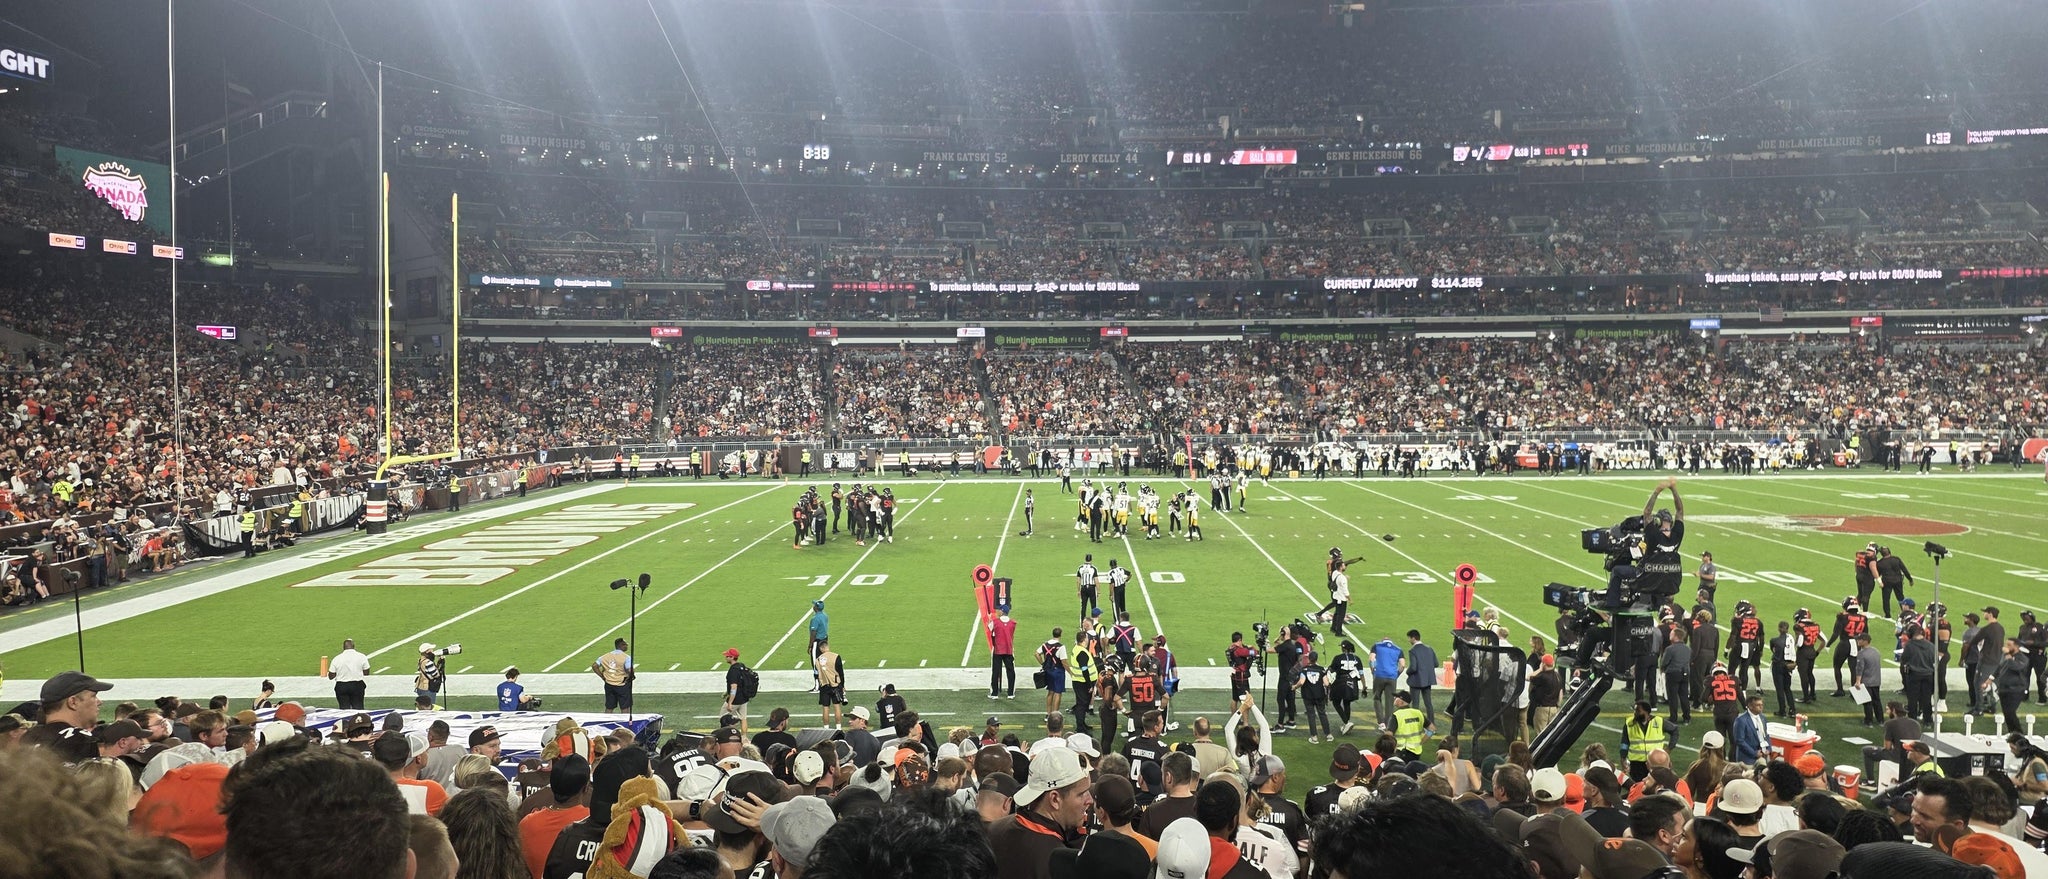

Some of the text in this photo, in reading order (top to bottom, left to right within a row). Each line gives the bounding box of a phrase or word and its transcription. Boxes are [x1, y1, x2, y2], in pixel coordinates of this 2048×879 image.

[0, 49, 49, 79] GHT
[500, 134, 586, 149] CHAMPIONSHIPS
[1605, 145, 1630, 154] MIKE
[1701, 141, 1713, 152] 74
[1757, 139, 1776, 149] JOE
[1868, 135, 1882, 146] 64
[923, 151, 1008, 163] FRANK GATSKI 52
[1060, 153, 1138, 164] LEROY KELLY 44
[1326, 150, 1422, 161] GENE HICKERSON 66
[1704, 273, 1714, 283] To
[1714, 273, 1750, 284] purchase
[1800, 273, 1818, 284] your
[1849, 271, 1859, 280] or
[1859, 270, 1877, 280] look
[1877, 269, 1890, 280] for
[1915, 268, 1942, 279] Kiosks
[929, 282, 938, 291] To
[938, 282, 971, 292] purchase
[999, 283, 1016, 291] scan
[1016, 283, 1033, 293] your
[1059, 283, 1068, 291] or
[1068, 282, 1084, 291] look
[1084, 282, 1096, 291] for
[1096, 281, 1116, 291] 50/50
[1324, 277, 1419, 289] CURRENT JACKPOT
[705, 336, 751, 345] Huntington
[1006, 336, 1048, 345] Huntington
[1048, 336, 1067, 344] Bank
[1291, 333, 1333, 341] Huntington
[208, 494, 362, 549] DAW POUND
[290, 502, 697, 588] BROWNS
[807, 574, 889, 586] 10
[998, 581, 1006, 598] 1
[1740, 623, 1758, 640] 23
[1845, 621, 1865, 638] 44
[1131, 683, 1155, 703] 50
[1712, 680, 1737, 701] 25
[672, 749, 699, 762] GARRETT
